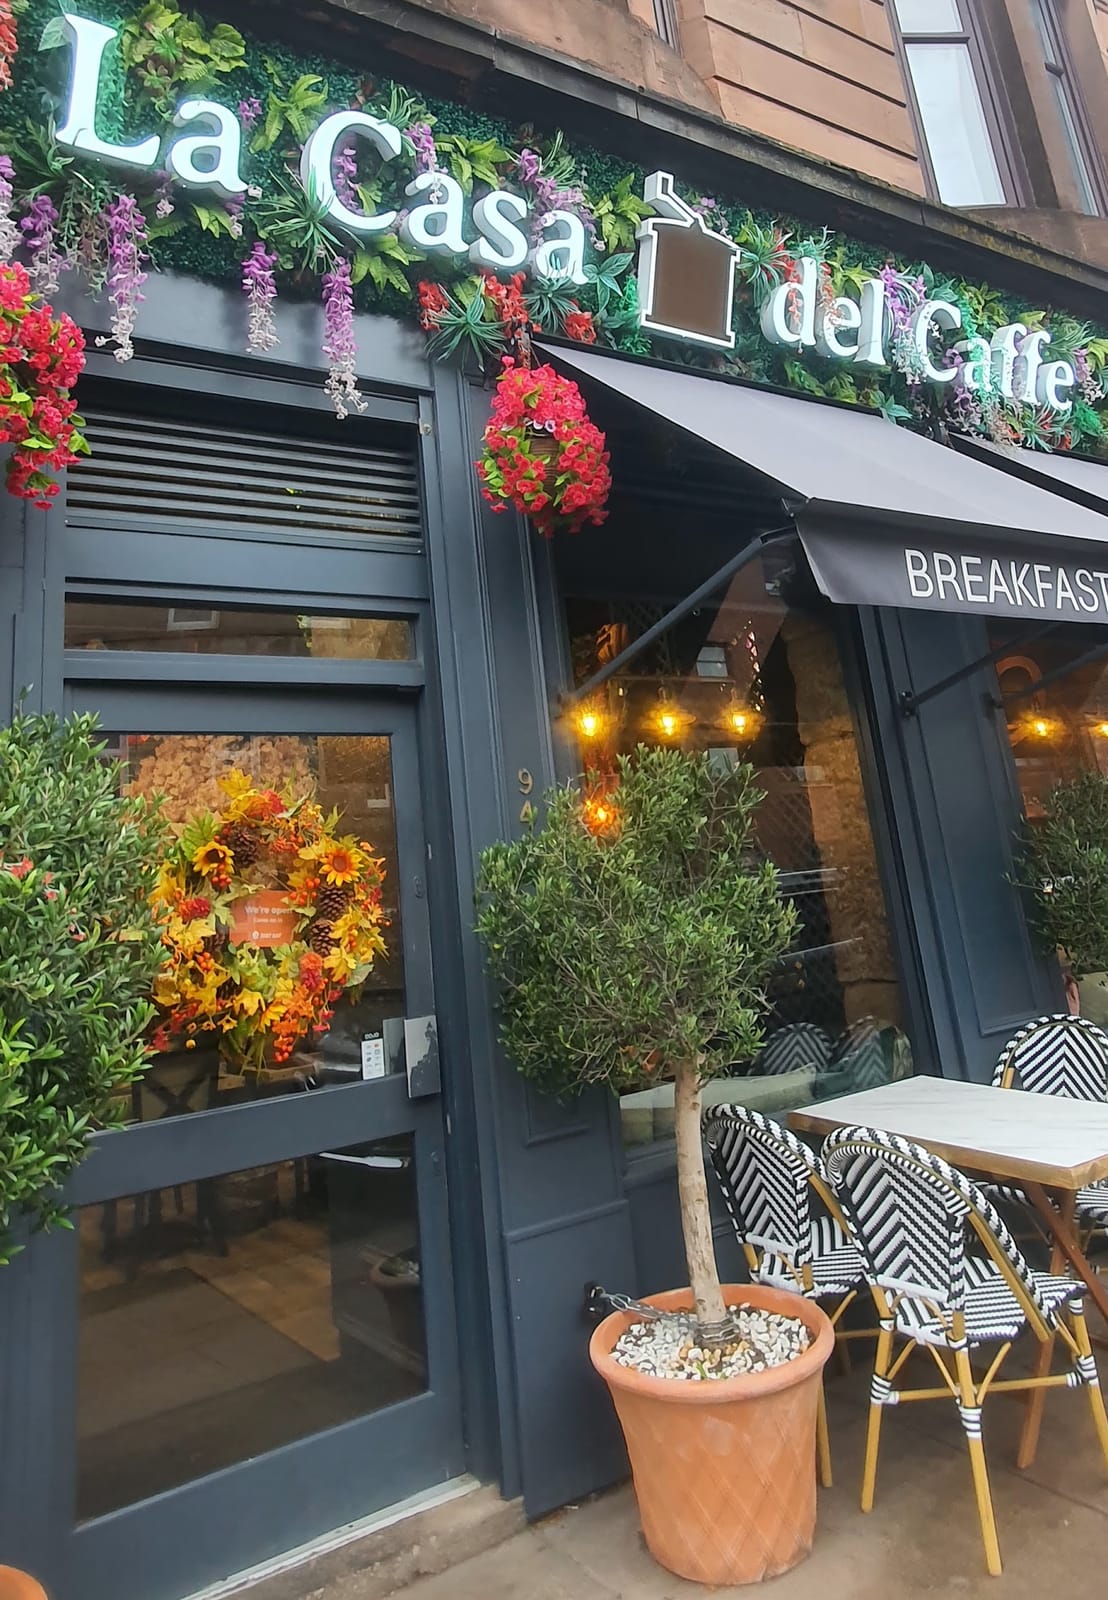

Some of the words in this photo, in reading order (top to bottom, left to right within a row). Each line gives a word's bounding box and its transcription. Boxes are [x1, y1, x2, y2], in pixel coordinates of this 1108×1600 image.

[54, 13, 249, 195] La
[302, 110, 590, 286] Casa
[765, 256, 887, 366] del
[913, 300, 1075, 412] Caffe
[904, 548, 1108, 614] BREAKFAST
